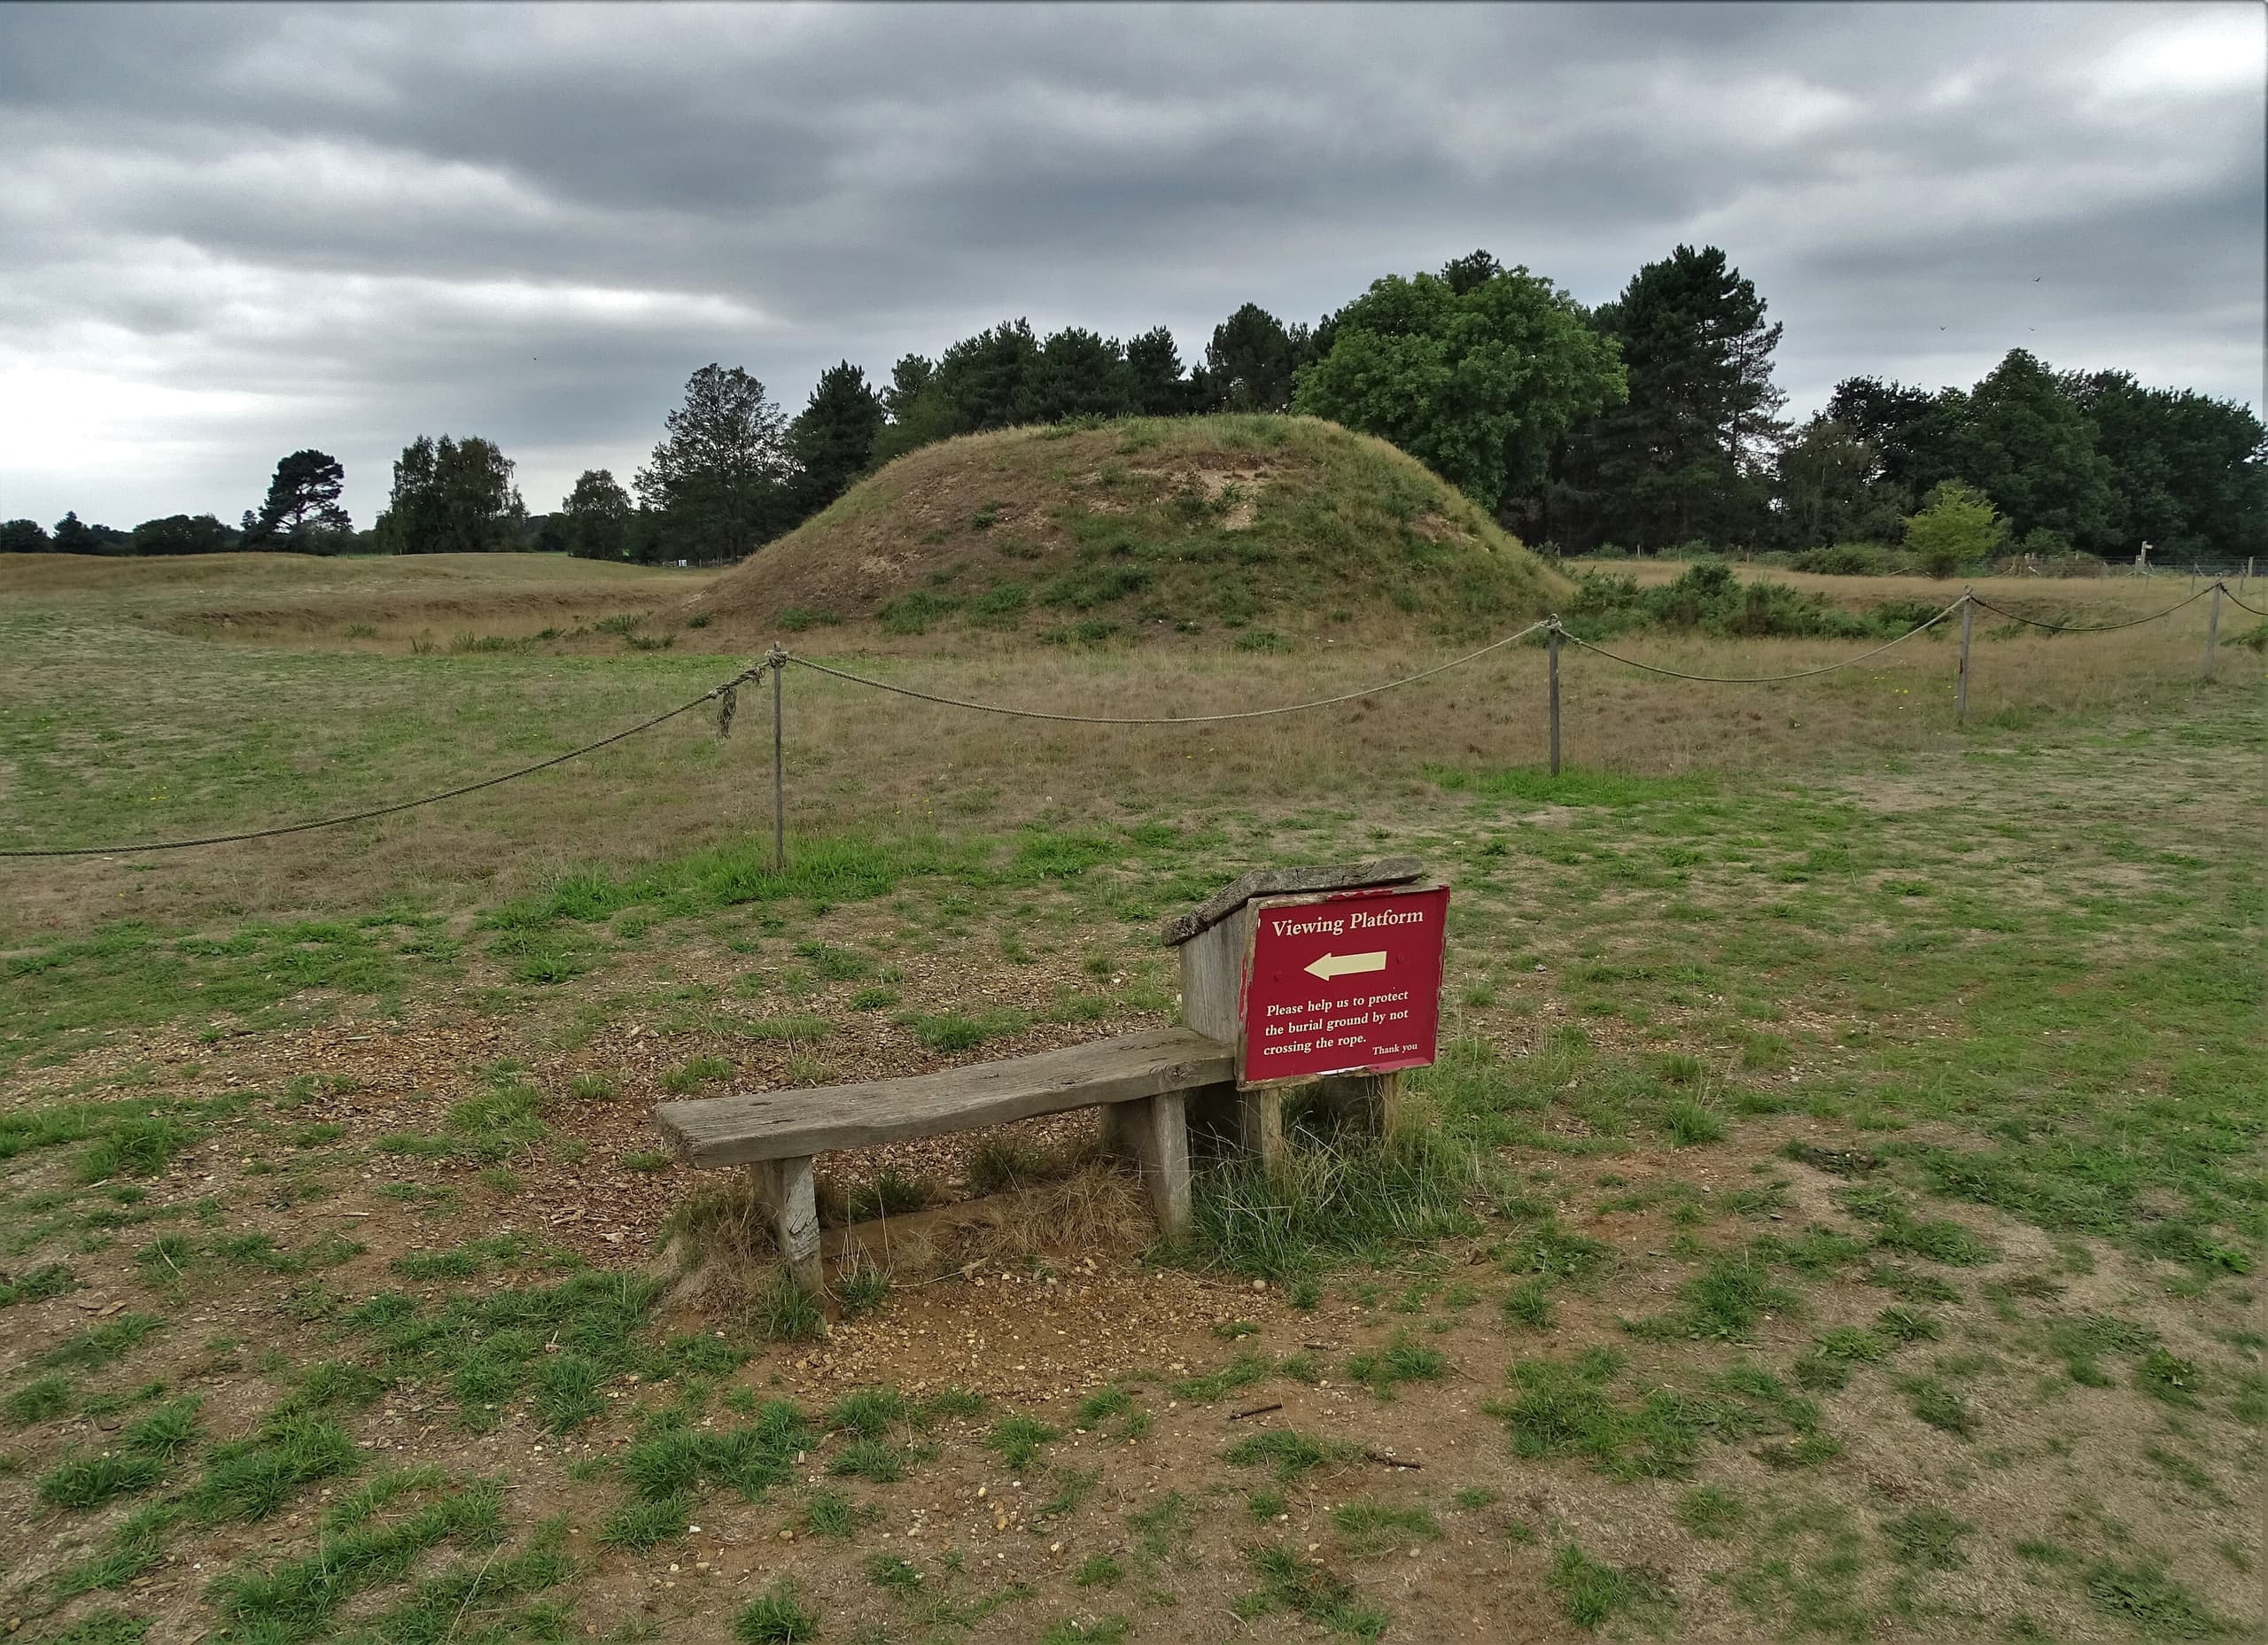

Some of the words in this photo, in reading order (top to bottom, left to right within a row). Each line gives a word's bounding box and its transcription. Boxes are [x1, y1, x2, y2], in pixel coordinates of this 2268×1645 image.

[1271, 916, 1345, 937] Viewing
[1349, 909, 1424, 929] Platform
[1266, 1004, 1304, 1017] Please
[1307, 998, 1332, 1013] help
[1336, 999, 1349, 1008] us
[1353, 997, 1365, 1006] to
[1368, 990, 1409, 1008] protect
[1265, 1024, 1285, 1036] the
[1288, 1019, 1323, 1034] burial
[1326, 1013, 1369, 1032] ground
[1372, 1012, 1386, 1025] by
[1389, 1009, 1409, 1020] not
[1263, 1040, 1312, 1056] crossing
[1316, 1036, 1334, 1049] the
[1338, 1035, 1367, 1048] rope.
[1371, 1044, 1400, 1056] Thank
[1402, 1044, 1418, 1053] you
